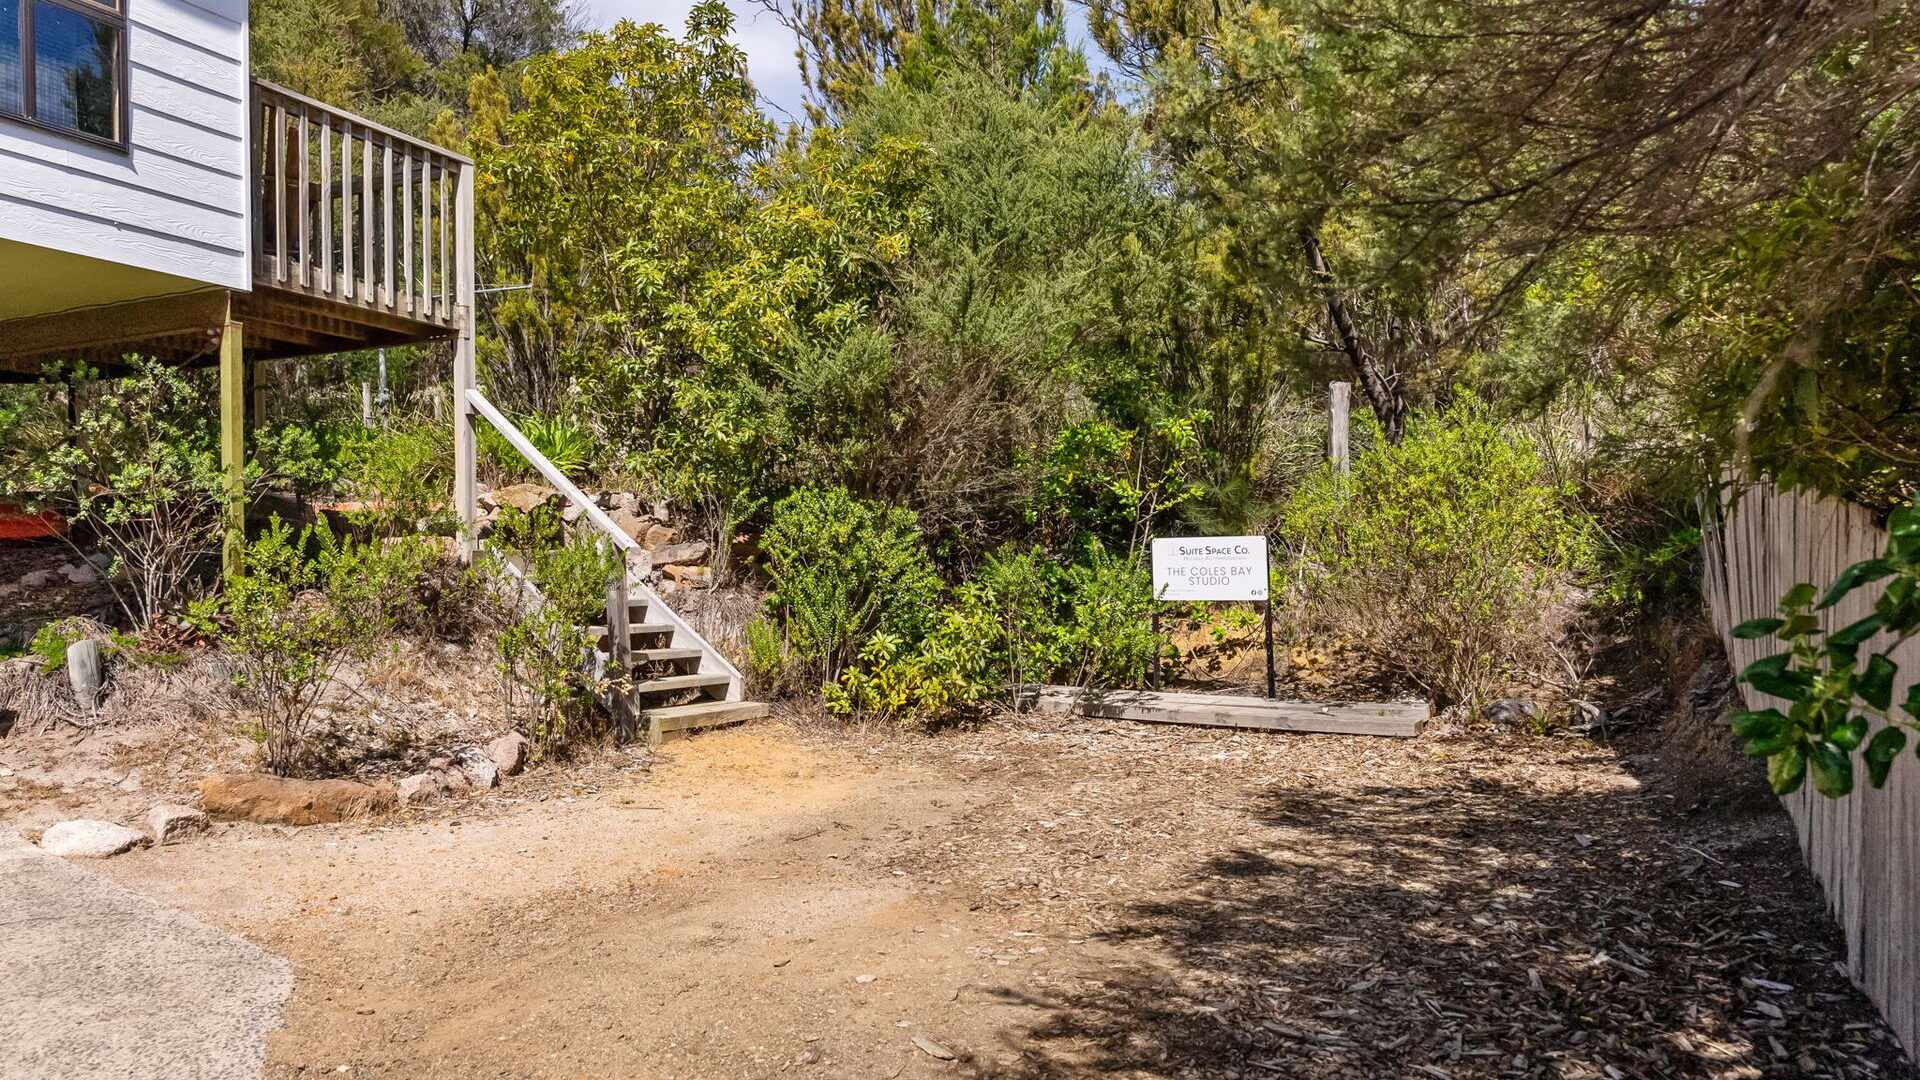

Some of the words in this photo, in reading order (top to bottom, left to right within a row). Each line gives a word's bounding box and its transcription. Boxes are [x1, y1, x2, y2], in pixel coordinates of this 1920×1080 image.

[1167, 567, 1186, 576] THE
[1190, 566, 1226, 576] COLES
[1231, 566, 1252, 576] BAY
[1189, 576, 1230, 586] STUDIO
